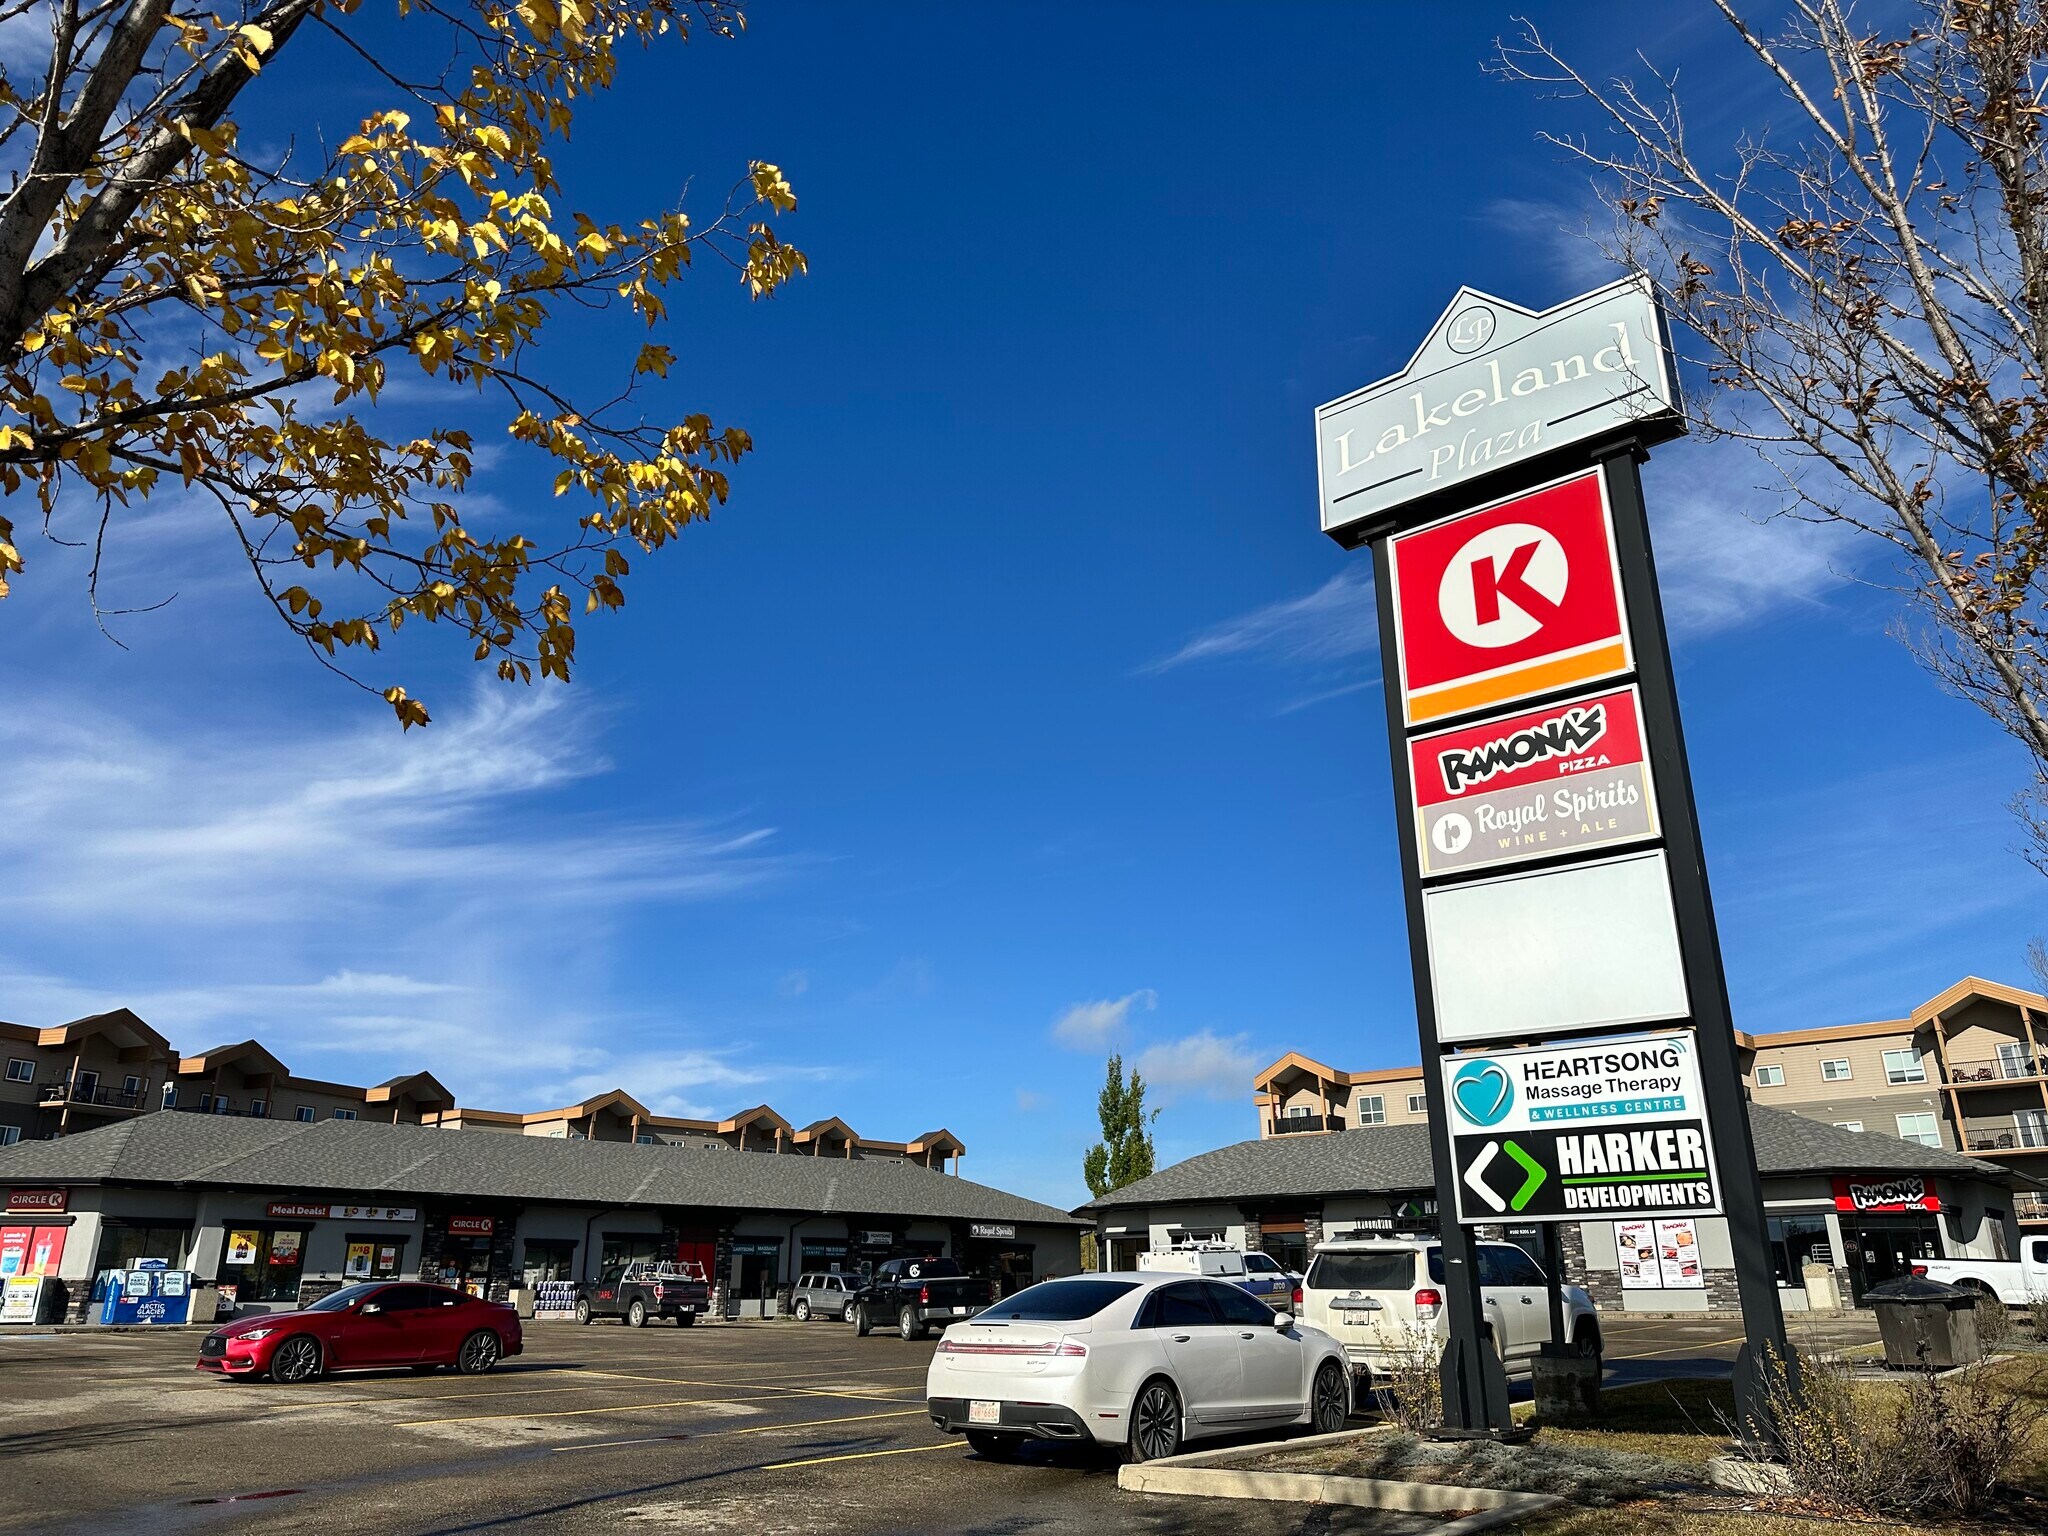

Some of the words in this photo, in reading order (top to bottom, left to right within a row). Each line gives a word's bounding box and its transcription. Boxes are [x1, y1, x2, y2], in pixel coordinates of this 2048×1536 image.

[1451, 315, 1493, 346] LP
[1333, 321, 1641, 477] Lakeland
[1426, 423, 1543, 481] Plaza
[1469, 538, 1562, 628] K
[1440, 705, 1602, 791] RAMONA'S
[1559, 754, 1611, 774] PIZZA
[1474, 793, 1548, 833] Royal
[1553, 779, 1639, 822] Spirits
[1498, 831, 1547, 849] WINE
[1580, 818, 1618, 834] ALE
[1523, 1049, 1679, 1081] HEARTSONG
[1526, 1081, 1602, 1101] Massage
[1605, 1075, 1682, 1096] Therapy
[1531, 1110, 1541, 1121] &
[1543, 1103, 1618, 1119] WELLNESS
[1624, 1098, 1682, 1112] CENTRE
[1556, 1128, 1706, 1176] HARKER
[11, 1195, 47, 1204] CIRCLE
[48, 1193, 62, 1206] K
[1563, 1182, 1711, 1209] DEVELOPMENTS
[272, 1206, 296, 1214] Meal
[297, 1206, 326, 1215] Deals!
[453, 1220, 480, 1228] CIRCLE
[481, 1219, 492, 1231] K
[979, 1225, 996, 1236] Royal
[996, 1226, 1013, 1237] Spirits
[1273, 1282, 1286, 1290] ATCO
